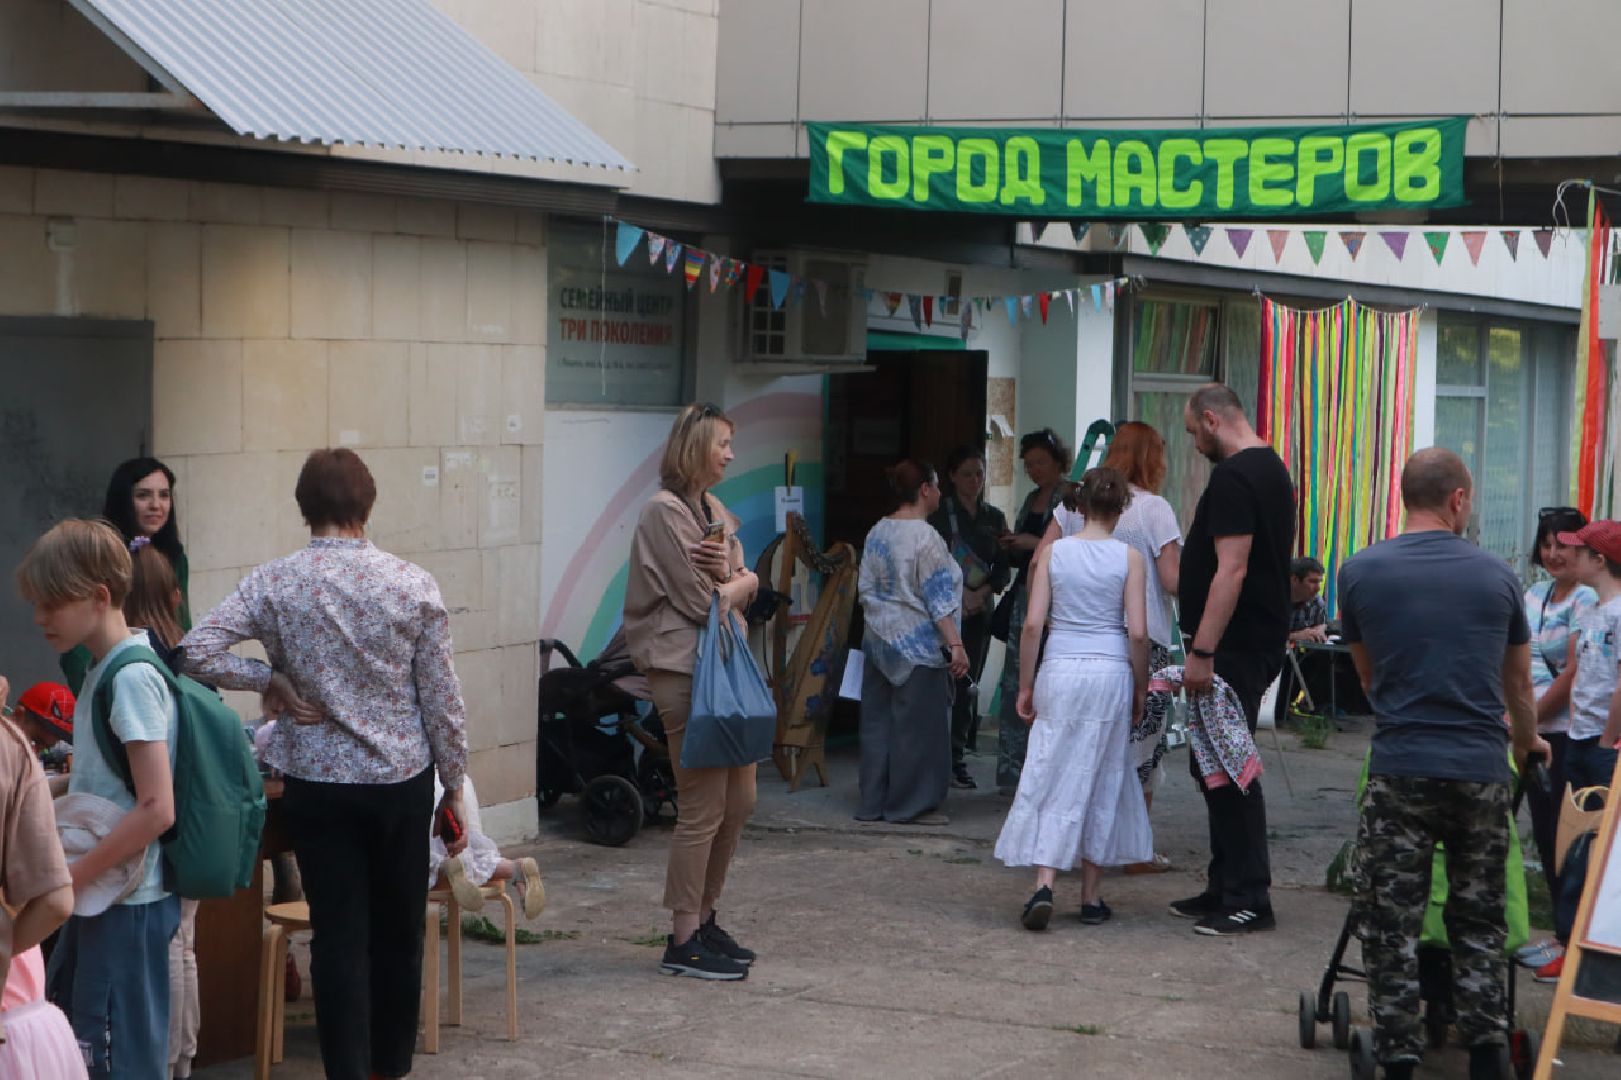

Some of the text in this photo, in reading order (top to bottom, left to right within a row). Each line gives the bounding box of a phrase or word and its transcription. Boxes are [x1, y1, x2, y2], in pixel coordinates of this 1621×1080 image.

[825, 128, 1442, 209] ГОРОД МАСТЕРОВ
[559, 318, 587, 342] ТРИ
